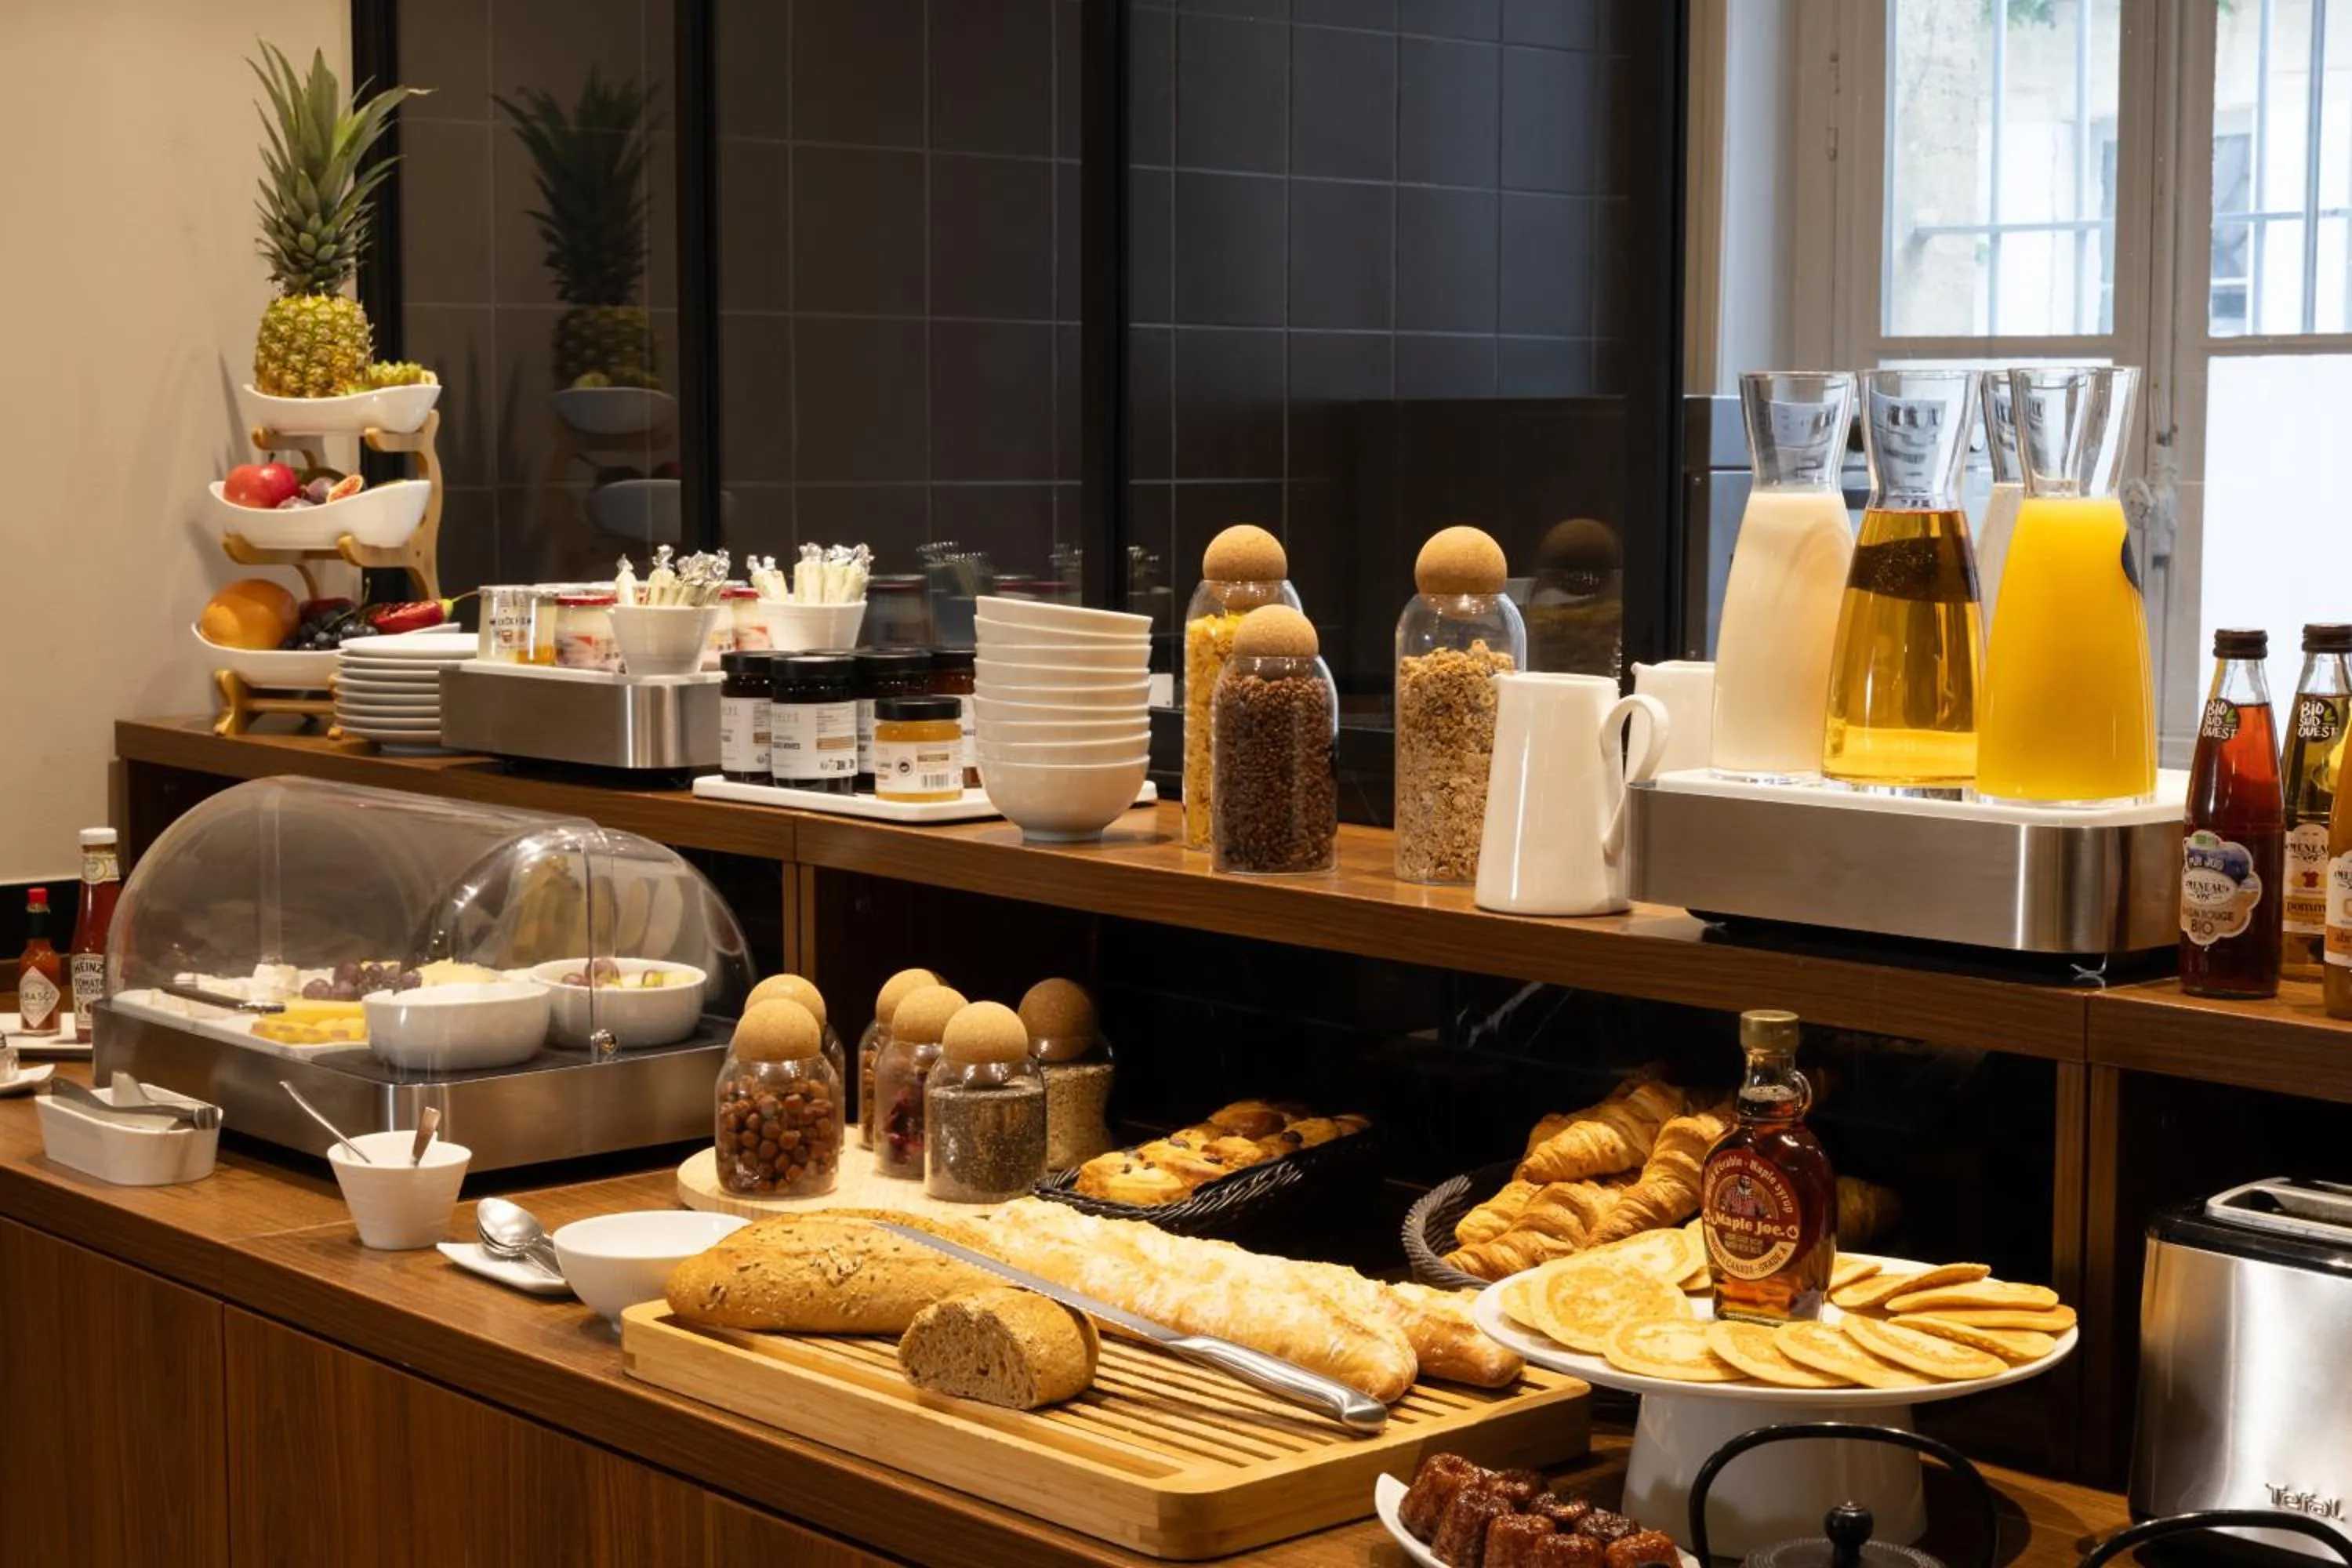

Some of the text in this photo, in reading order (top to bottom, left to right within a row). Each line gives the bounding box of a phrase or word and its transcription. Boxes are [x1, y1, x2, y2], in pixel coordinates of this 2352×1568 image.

[2299, 716, 2321, 728] SUD
[2201, 727, 2238, 739] OUEST
[2298, 727, 2336, 738] OUEST
